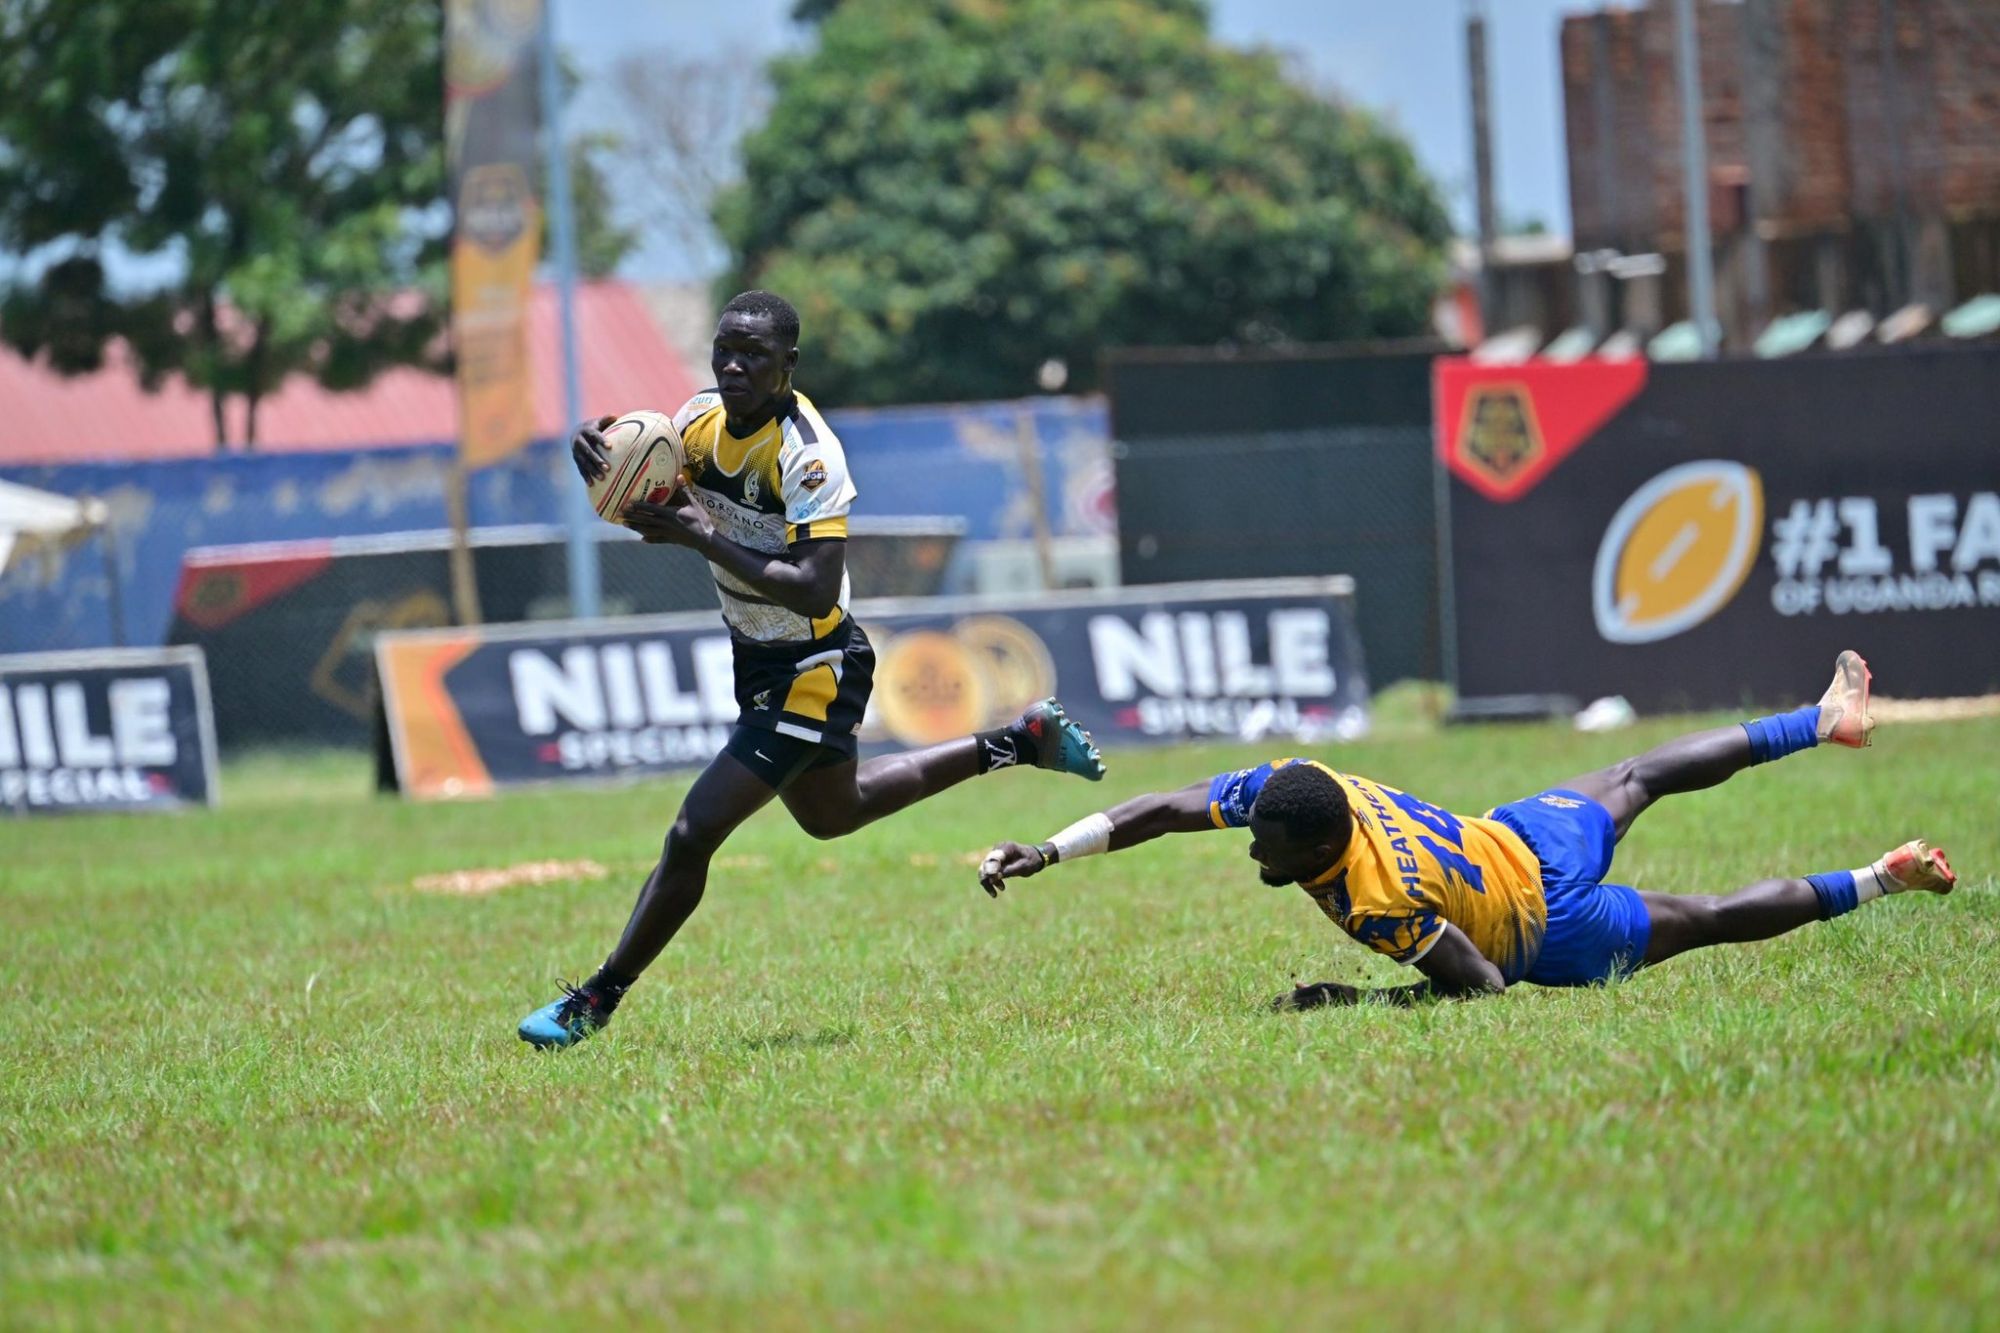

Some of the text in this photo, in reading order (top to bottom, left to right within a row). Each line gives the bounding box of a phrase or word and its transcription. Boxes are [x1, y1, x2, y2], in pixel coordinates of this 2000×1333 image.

[1770, 490, 2000, 578] #1 FA
[1770, 576, 1822, 617] OF
[1824, 571, 1977, 616] UGANDA
[1087, 608, 1337, 701] NILE
